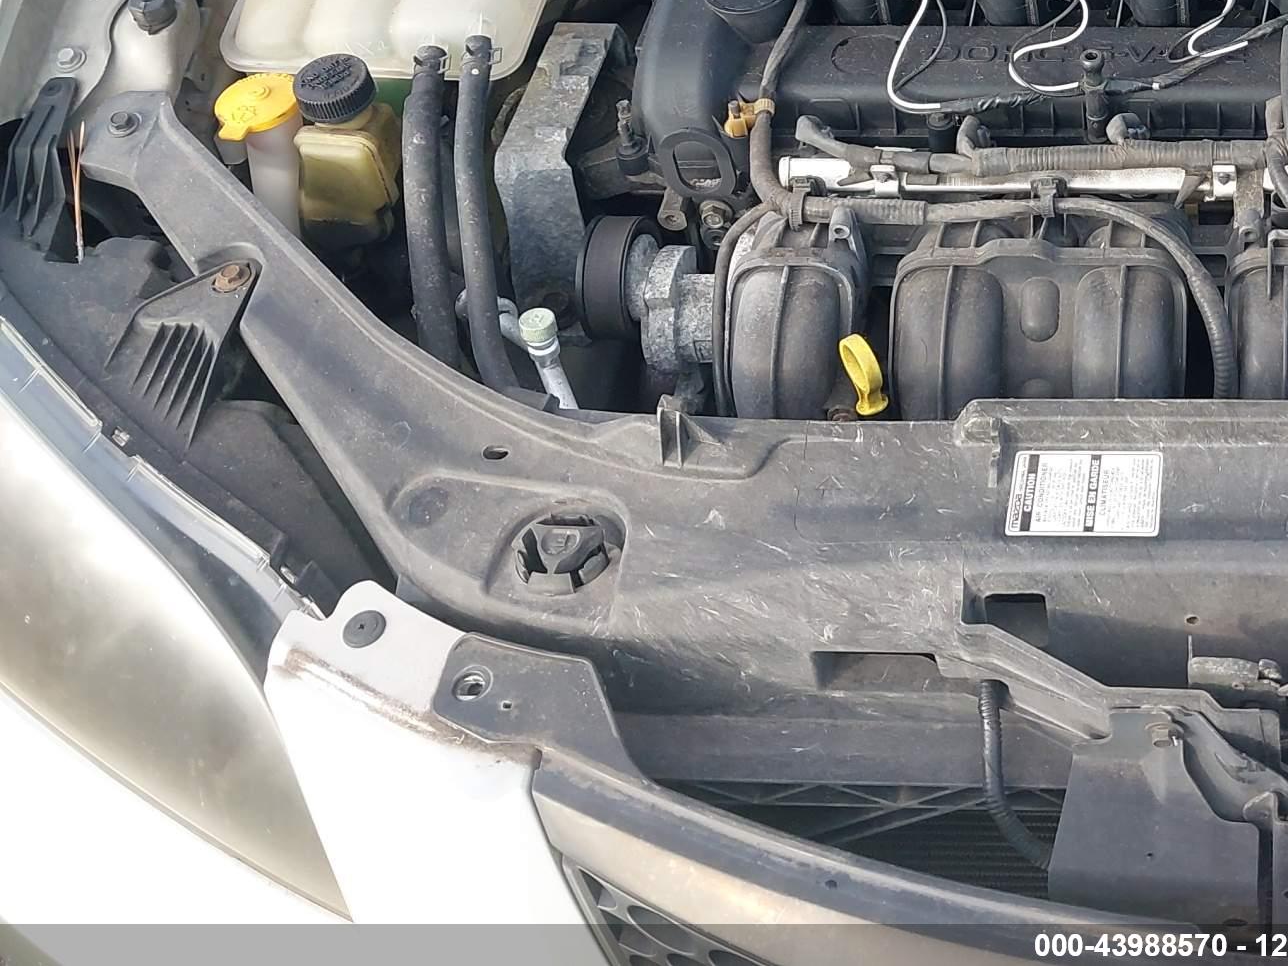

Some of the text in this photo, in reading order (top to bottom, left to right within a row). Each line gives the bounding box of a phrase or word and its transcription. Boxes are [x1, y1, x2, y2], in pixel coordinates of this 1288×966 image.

[1023, 472, 1037, 513] CAUTION
[1037, 461, 1049, 509] CONDITIONER
[1084, 458, 1101, 528] MISE EN GARDE
[1010, 493, 1023, 529] mazda
